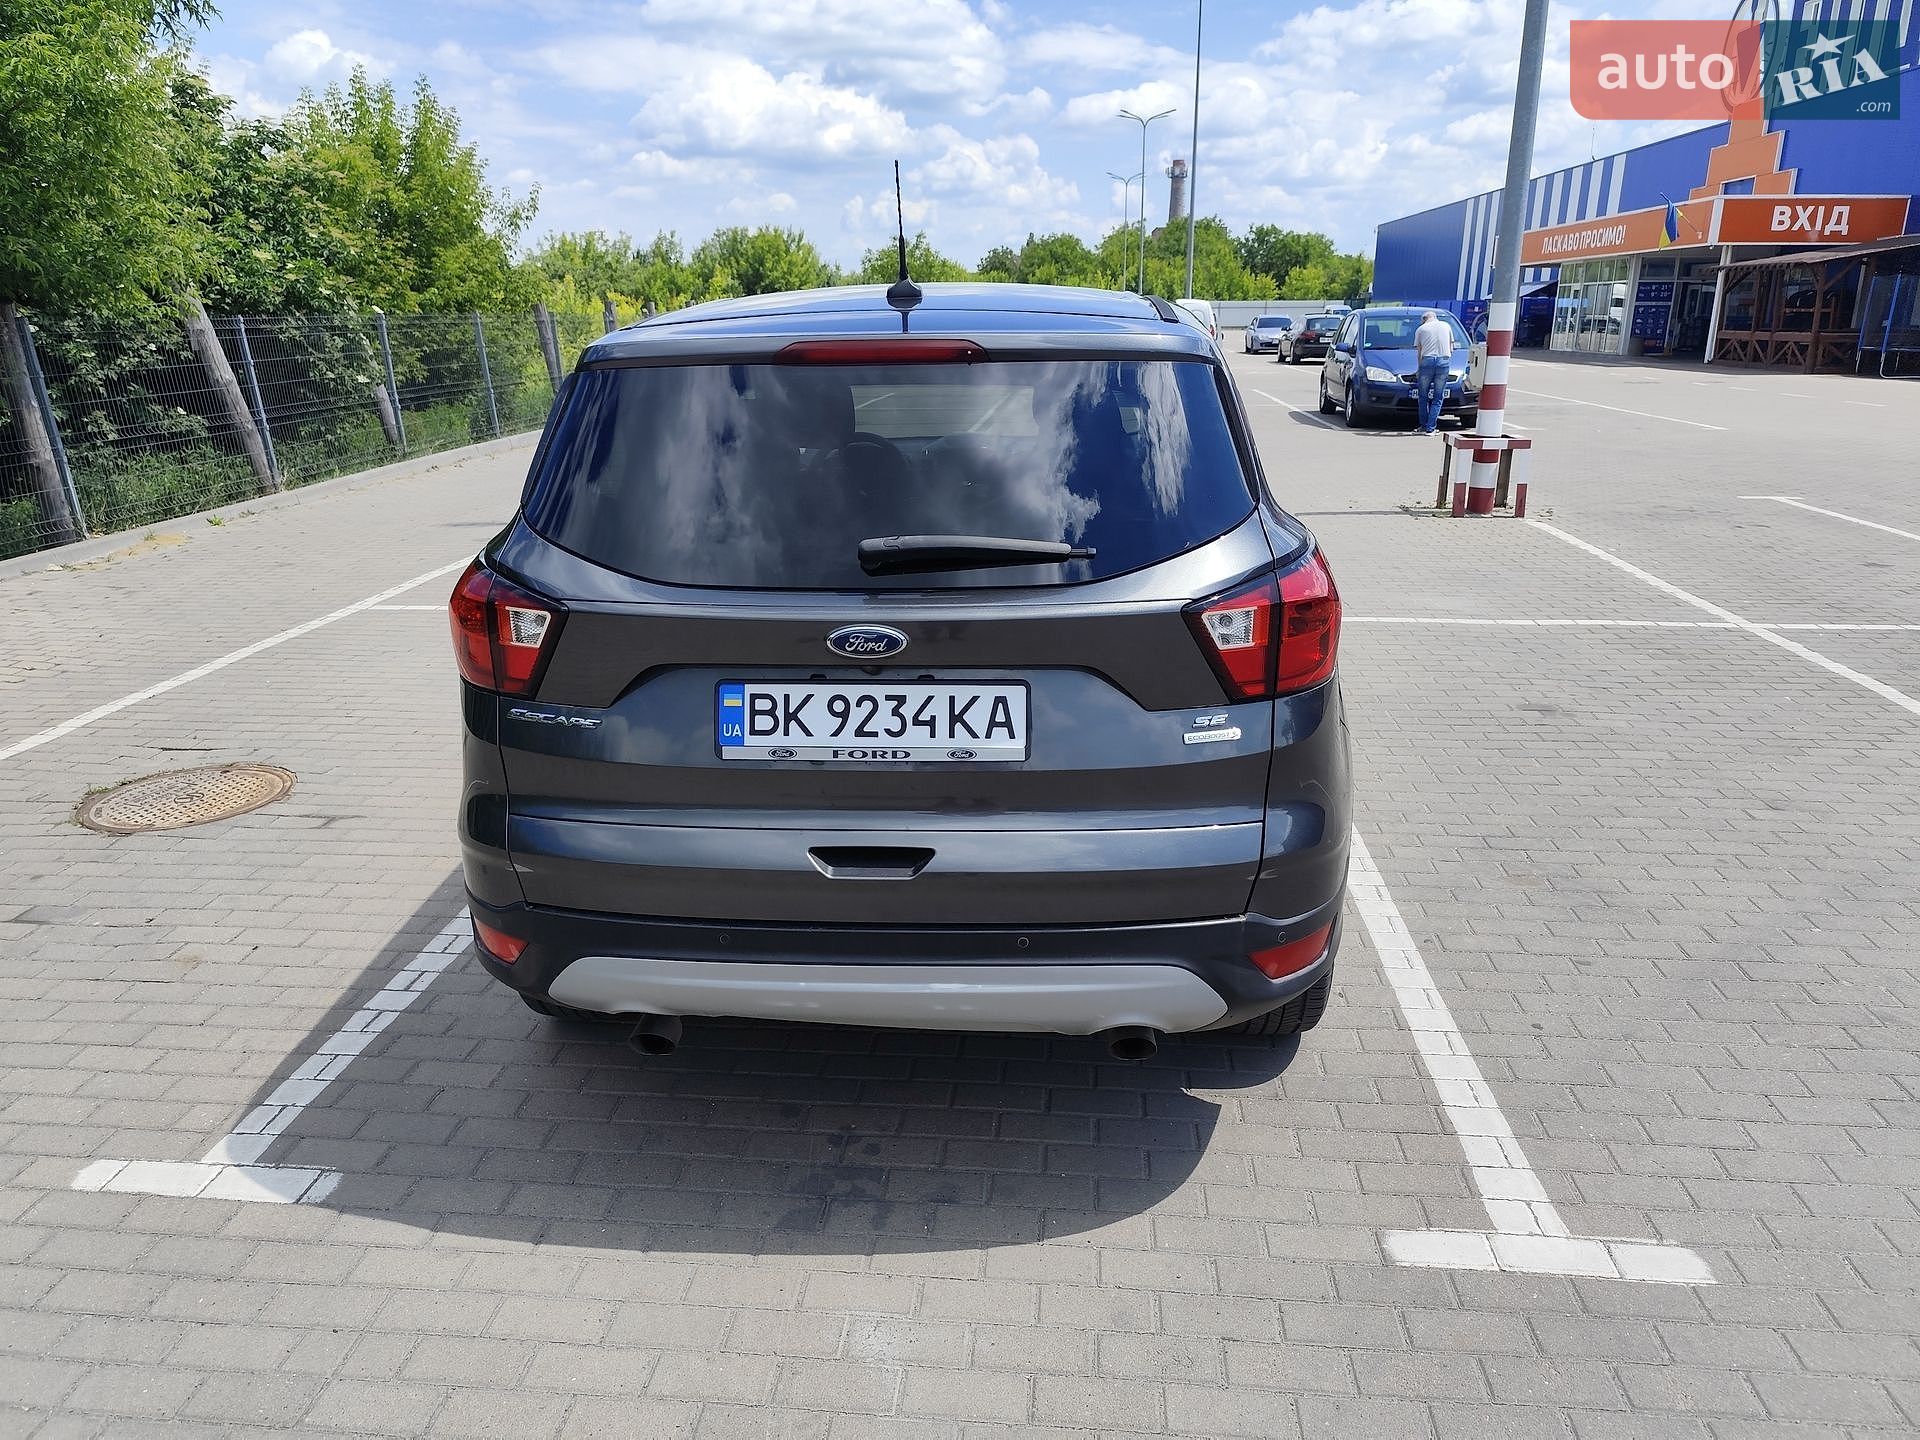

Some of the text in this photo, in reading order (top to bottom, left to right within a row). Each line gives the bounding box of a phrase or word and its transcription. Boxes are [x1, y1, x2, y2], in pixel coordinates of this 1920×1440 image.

[1770, 205, 1850, 236] ВХІД
[1541, 224, 1627, 255] ЛАСКАВО ПРОСИМО!
[845, 632, 888, 652] Ford
[826, 694, 937, 738] 9234
[1192, 713, 1229, 729] SE
[723, 723, 742, 737] UA
[832, 749, 911, 760] FORD
